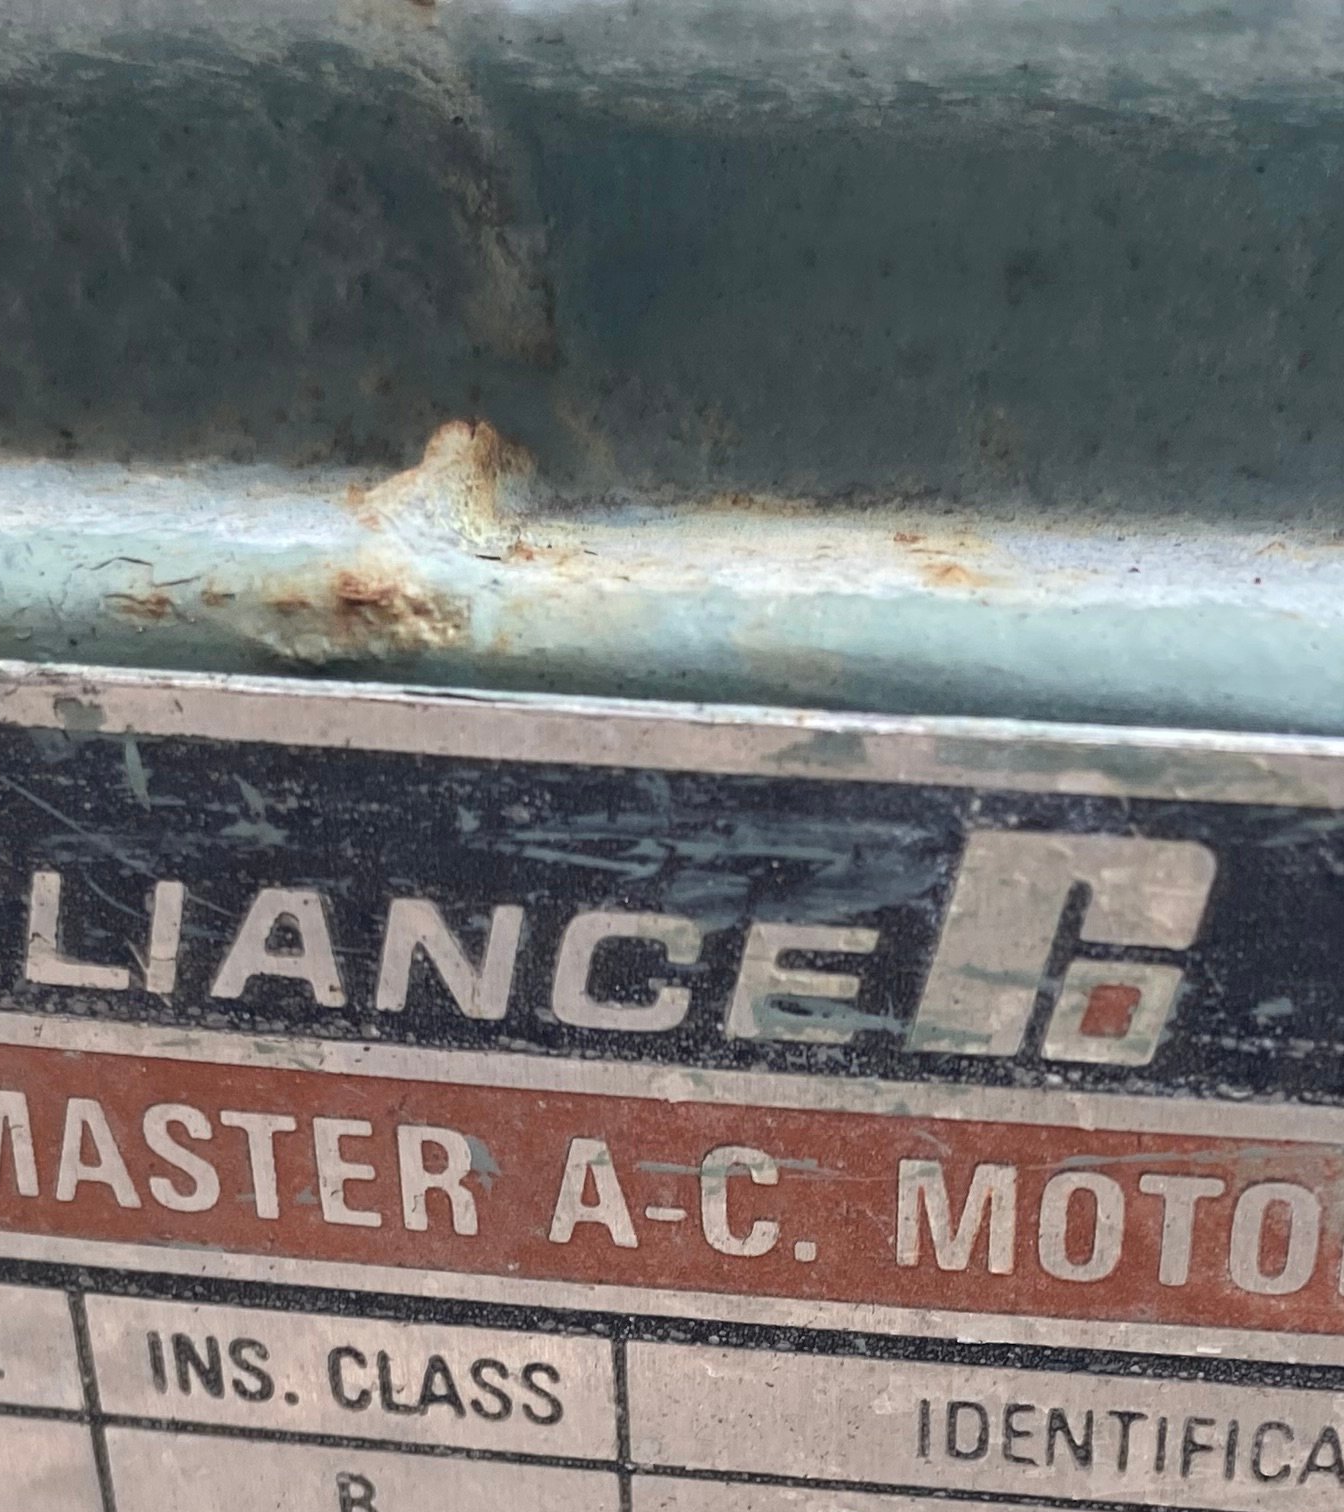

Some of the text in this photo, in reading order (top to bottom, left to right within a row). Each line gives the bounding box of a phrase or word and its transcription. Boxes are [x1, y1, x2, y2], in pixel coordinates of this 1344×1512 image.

[546, 1136, 816, 1263] A-C.
[147, 1327, 565, 1428] INS. CLASS
